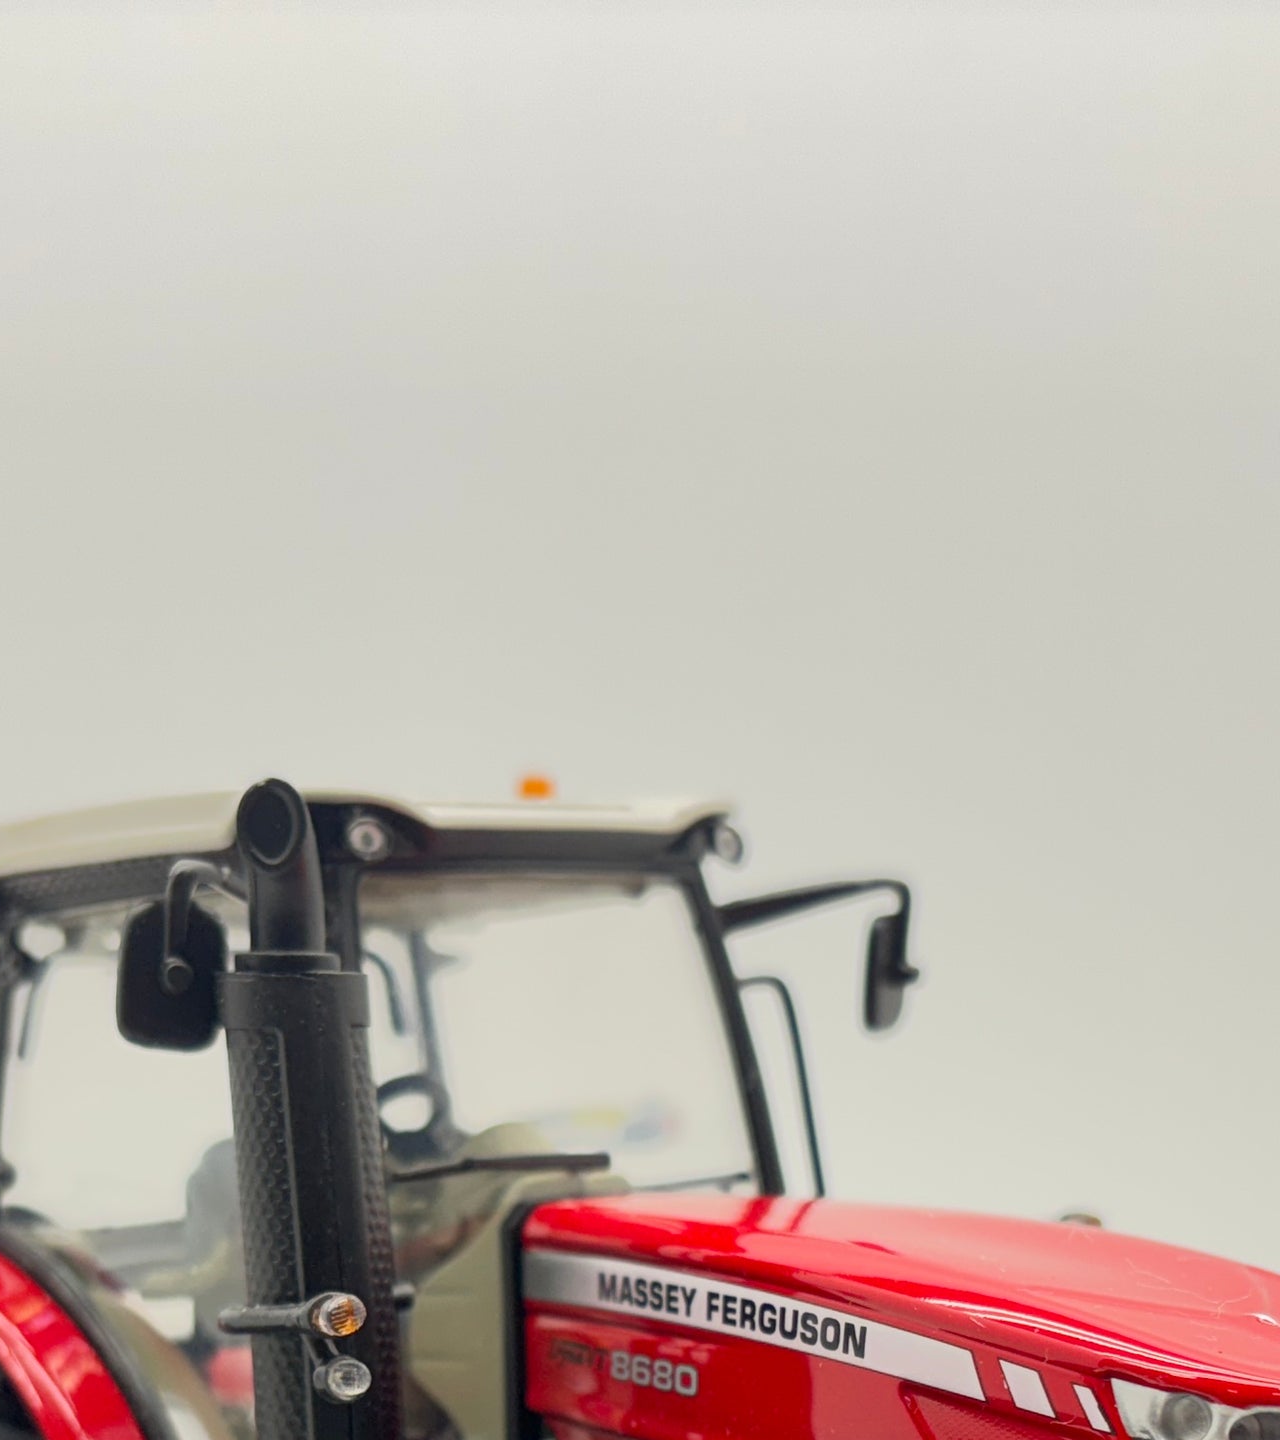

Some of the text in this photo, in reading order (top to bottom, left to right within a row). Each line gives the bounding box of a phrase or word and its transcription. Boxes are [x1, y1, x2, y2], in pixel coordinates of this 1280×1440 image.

[598, 1272, 868, 1359] MASSEY FERGUSON
[611, 1350, 699, 1396] 8680
